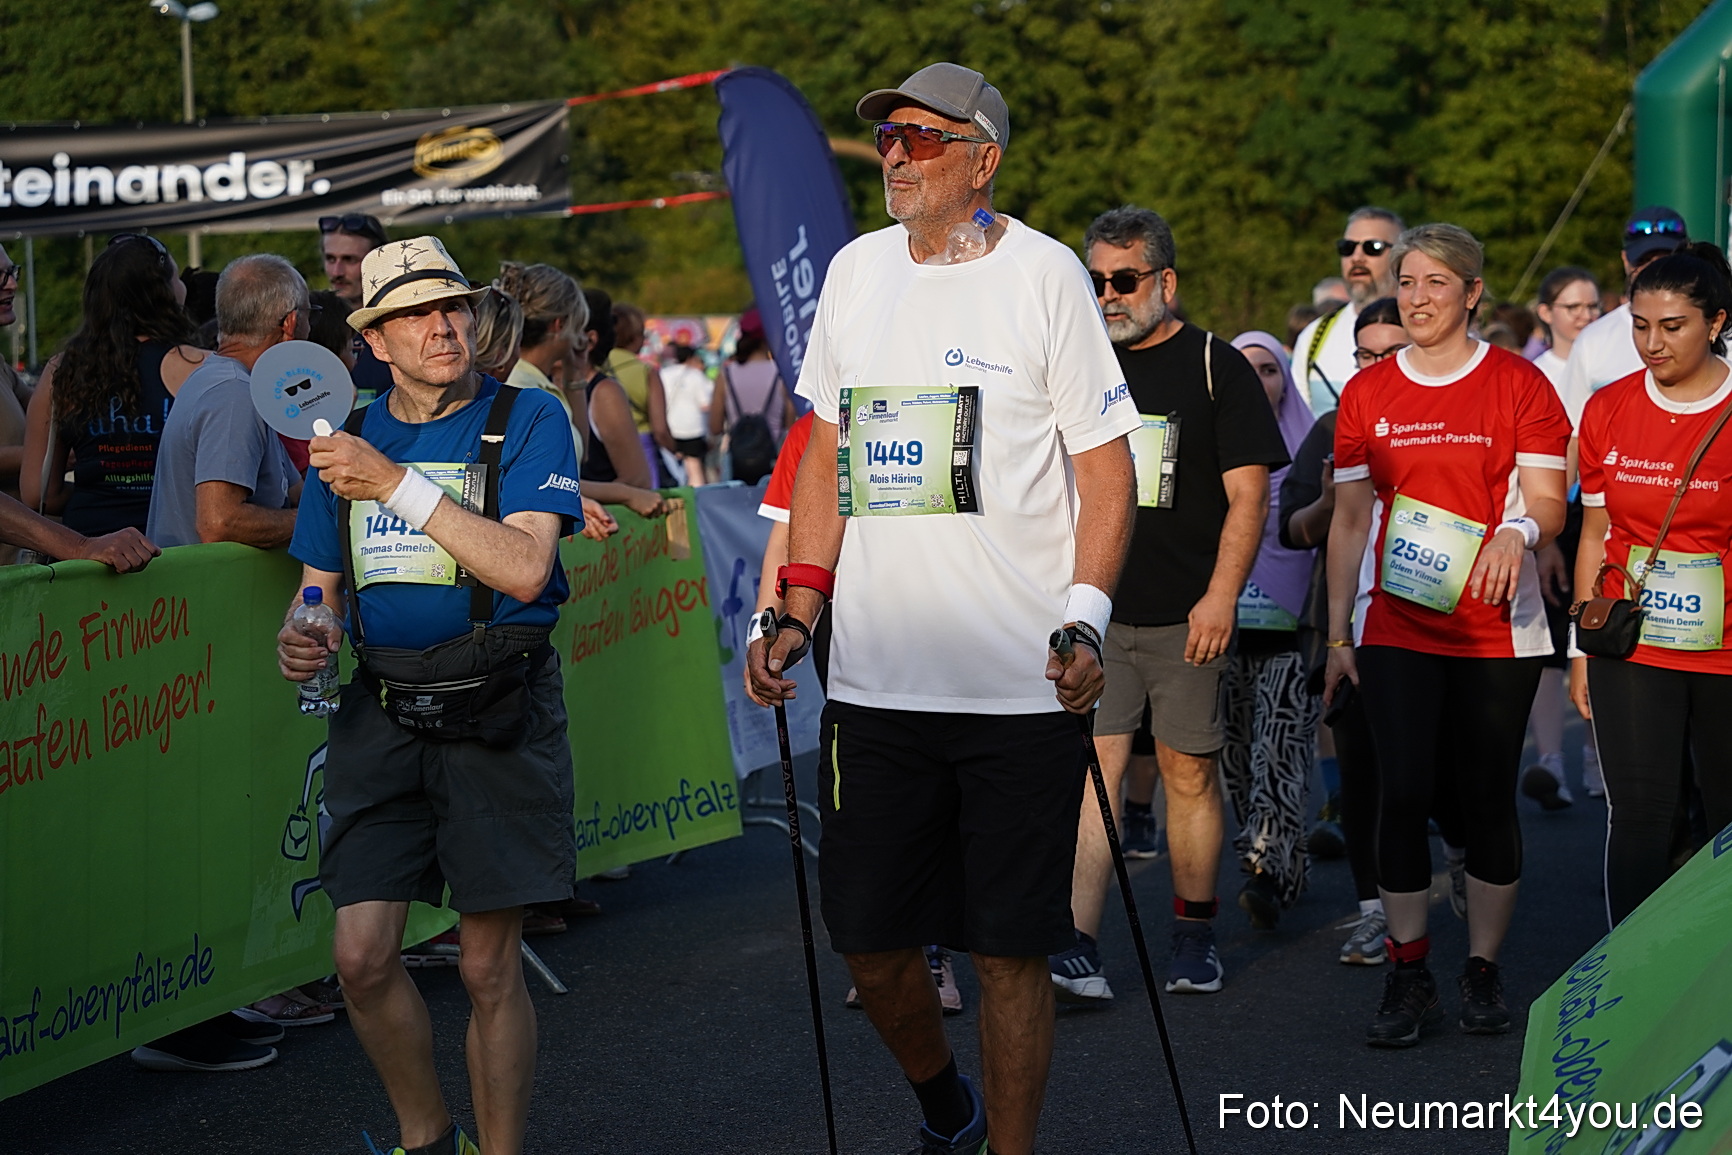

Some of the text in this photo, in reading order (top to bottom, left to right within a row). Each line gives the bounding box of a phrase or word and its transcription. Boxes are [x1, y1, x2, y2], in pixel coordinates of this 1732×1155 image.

[965, 355, 1013, 375] Lebenshilfe
[298, 390, 331, 408] Lebenshilfe
[957, 394, 965, 424] RABATT
[1101, 383, 1131, 416] JUR
[1390, 432, 1492, 448] Neumarkt-Parsberg
[1391, 421, 1446, 435] Sparkasse
[98, 443, 153, 453] Pflegedienst
[865, 441, 923, 467] 1449
[1620, 455, 1674, 471] Sparkasse
[463, 471, 472, 499] RABATT
[869, 473, 922, 486] Alois Häring
[955, 469, 967, 504] HILTL
[1615, 471, 1719, 492] Neumarkt-Psberg
[360, 543, 435, 556] Thomas Gmelch
[1391, 537, 1451, 573] 2596
[1390, 559, 1413, 576] Özlem
[1414, 569, 1443, 586] Yilmaz
[1641, 589, 1701, 614] 2543
[1644, 611, 1705, 627] asemin Demir
[79, 596, 190, 672] Firmen
[102, 643, 215, 754] länger!
[781, 760, 795, 805] EASY
[788, 810, 800, 848] WAY
